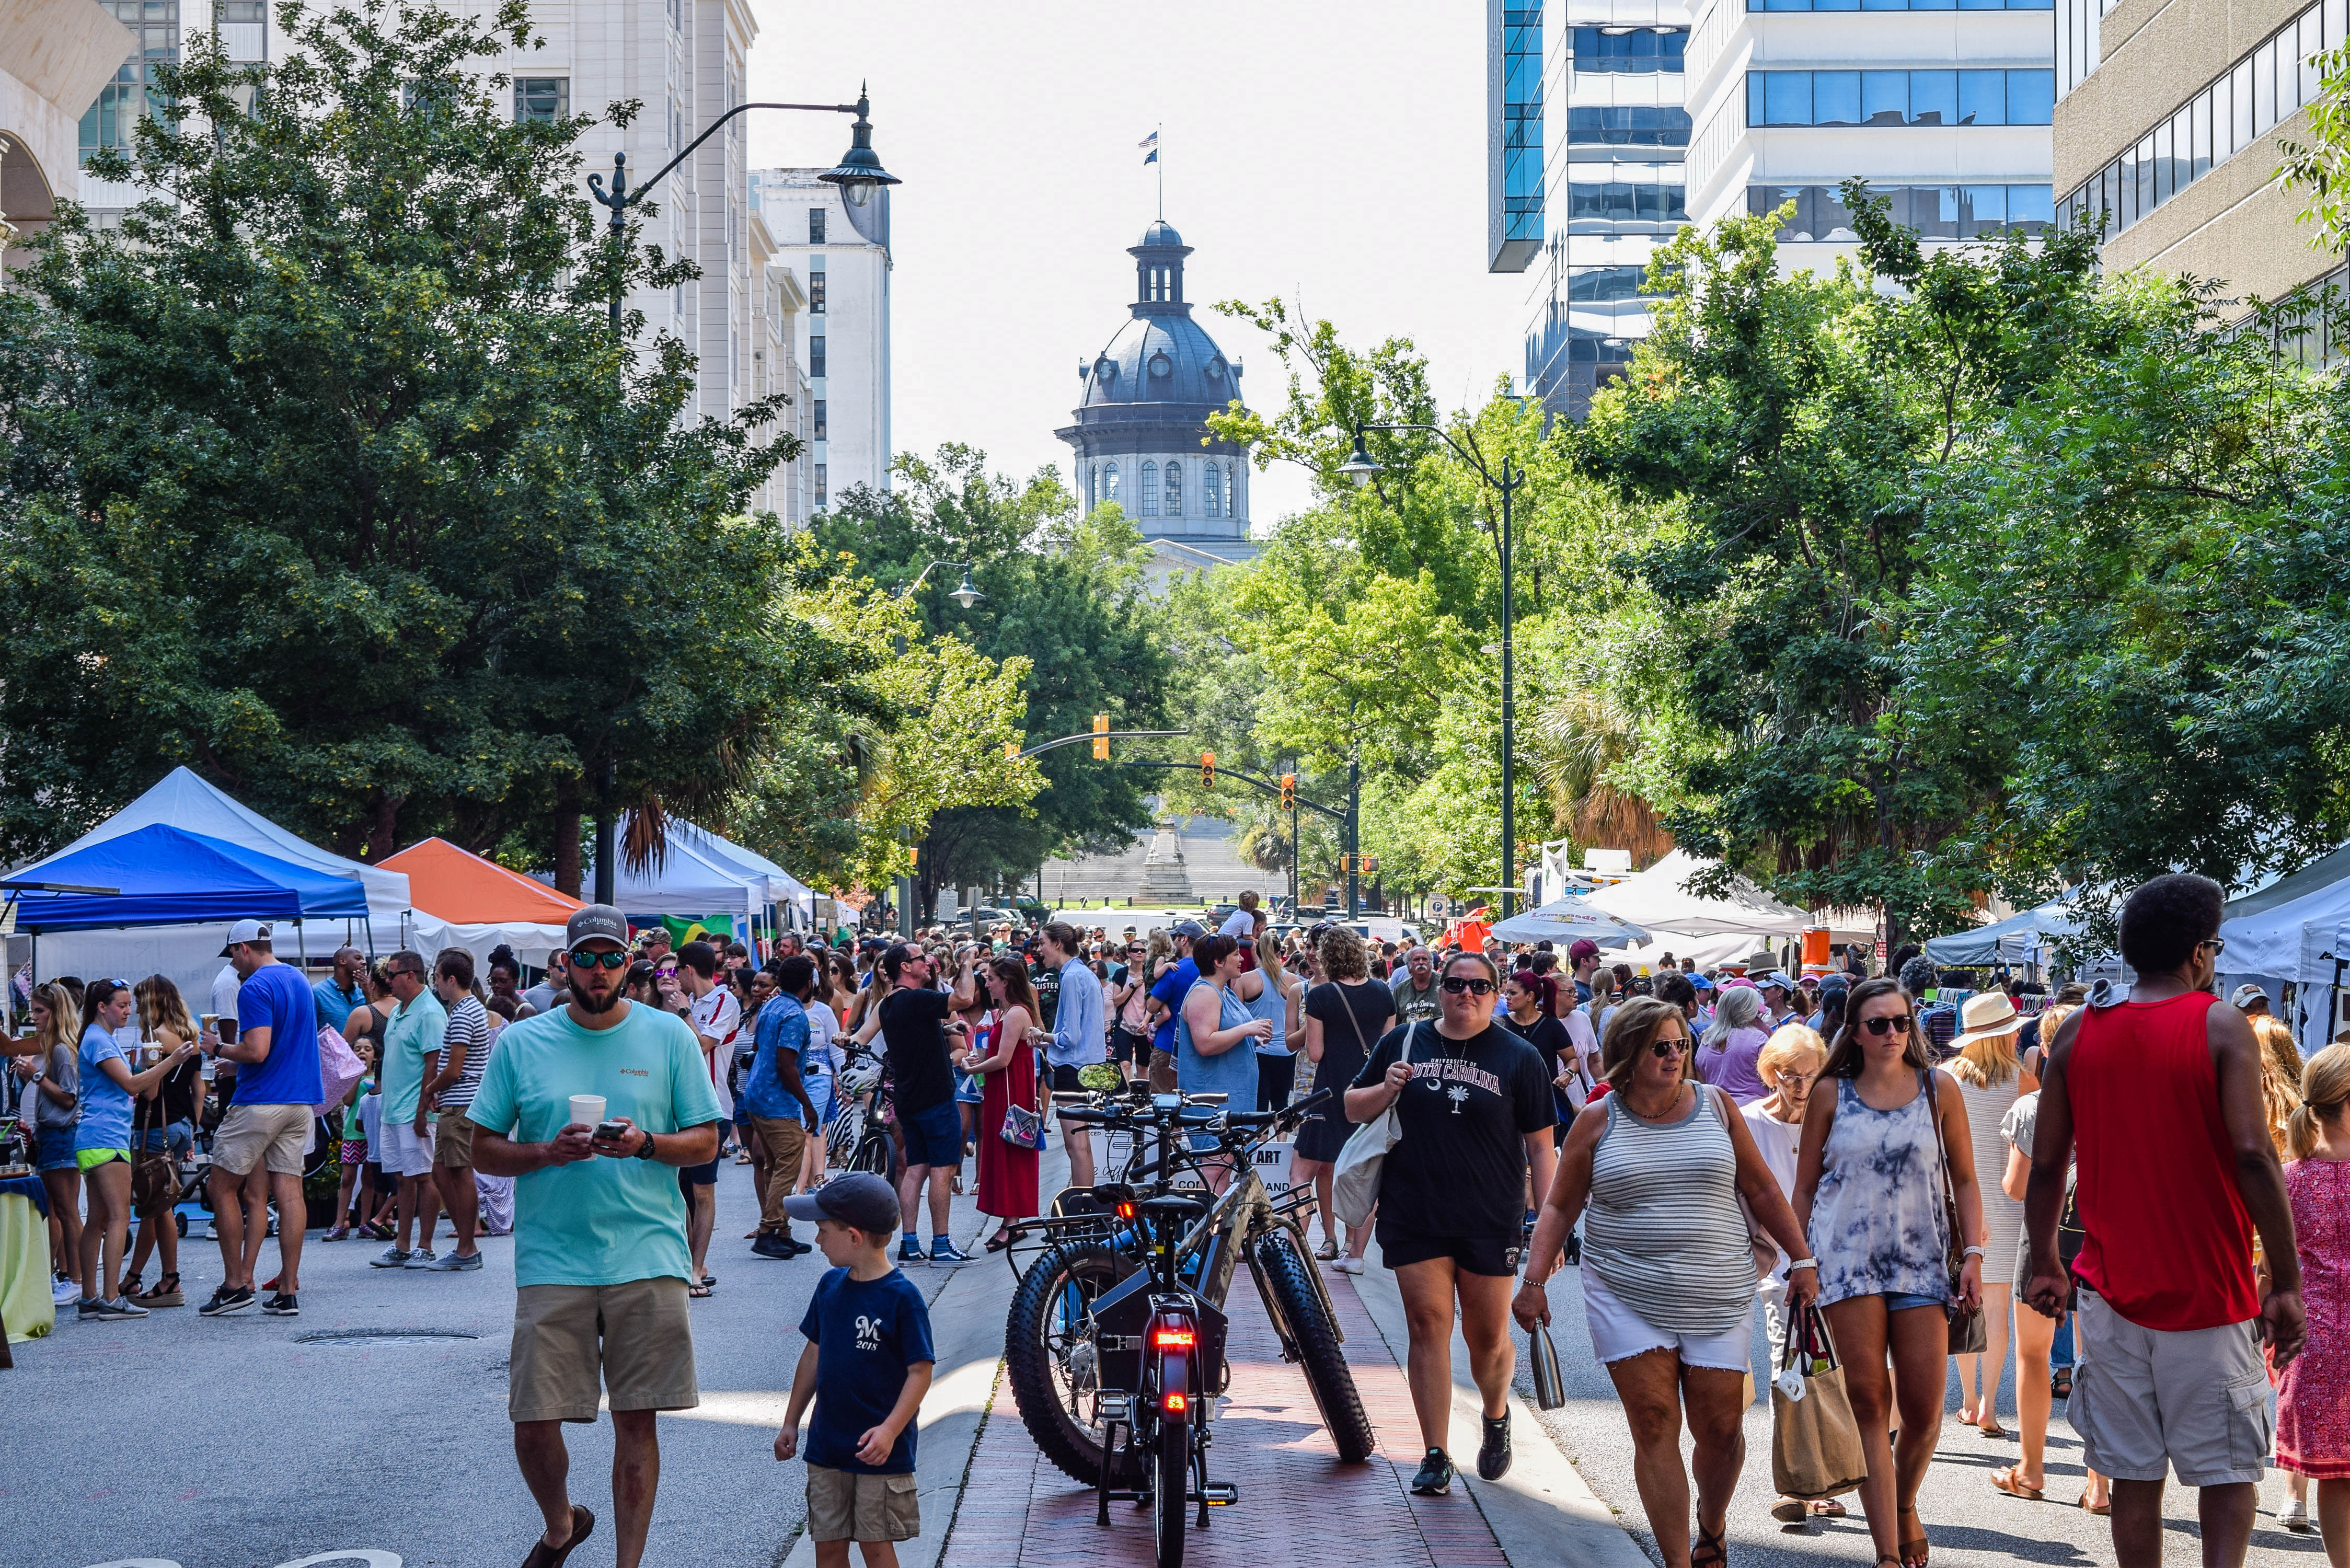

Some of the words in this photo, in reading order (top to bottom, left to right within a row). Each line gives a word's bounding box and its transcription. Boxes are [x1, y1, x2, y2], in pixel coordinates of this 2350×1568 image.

[1435, 902, 1441, 912] P
[584, 916, 617, 927] Columbia
[1530, 912, 1597, 921] Lemonade
[1443, 1064, 1502, 1097] CAROLINA
[1256, 1150, 1281, 1163] ART
[855, 1315, 882, 1341] M
[856, 1340, 878, 1351] 2018
